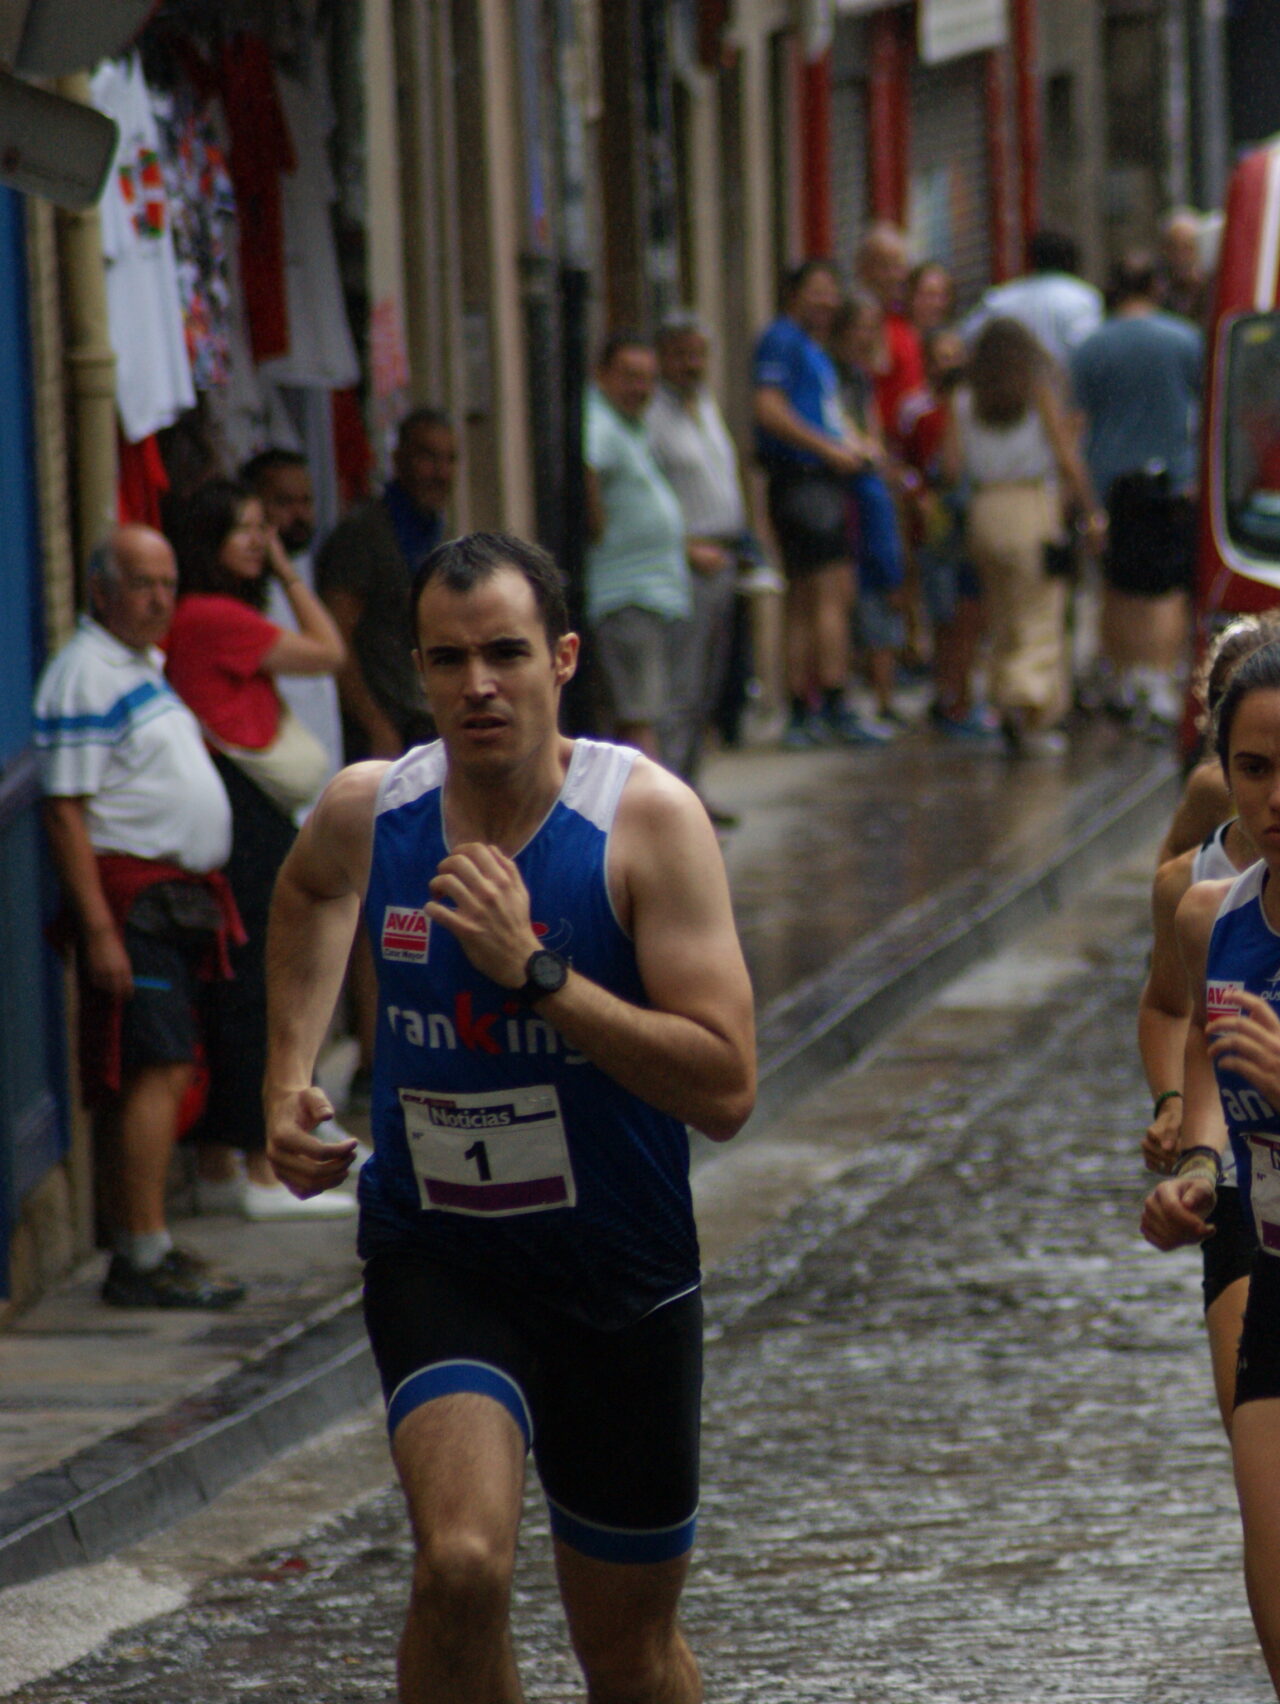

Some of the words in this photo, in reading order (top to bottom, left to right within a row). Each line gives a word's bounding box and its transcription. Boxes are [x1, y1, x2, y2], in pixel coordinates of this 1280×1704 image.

[387, 991, 588, 1065] rankin
[431, 1106, 512, 1128] Noticias
[464, 1140, 492, 1182] 1
